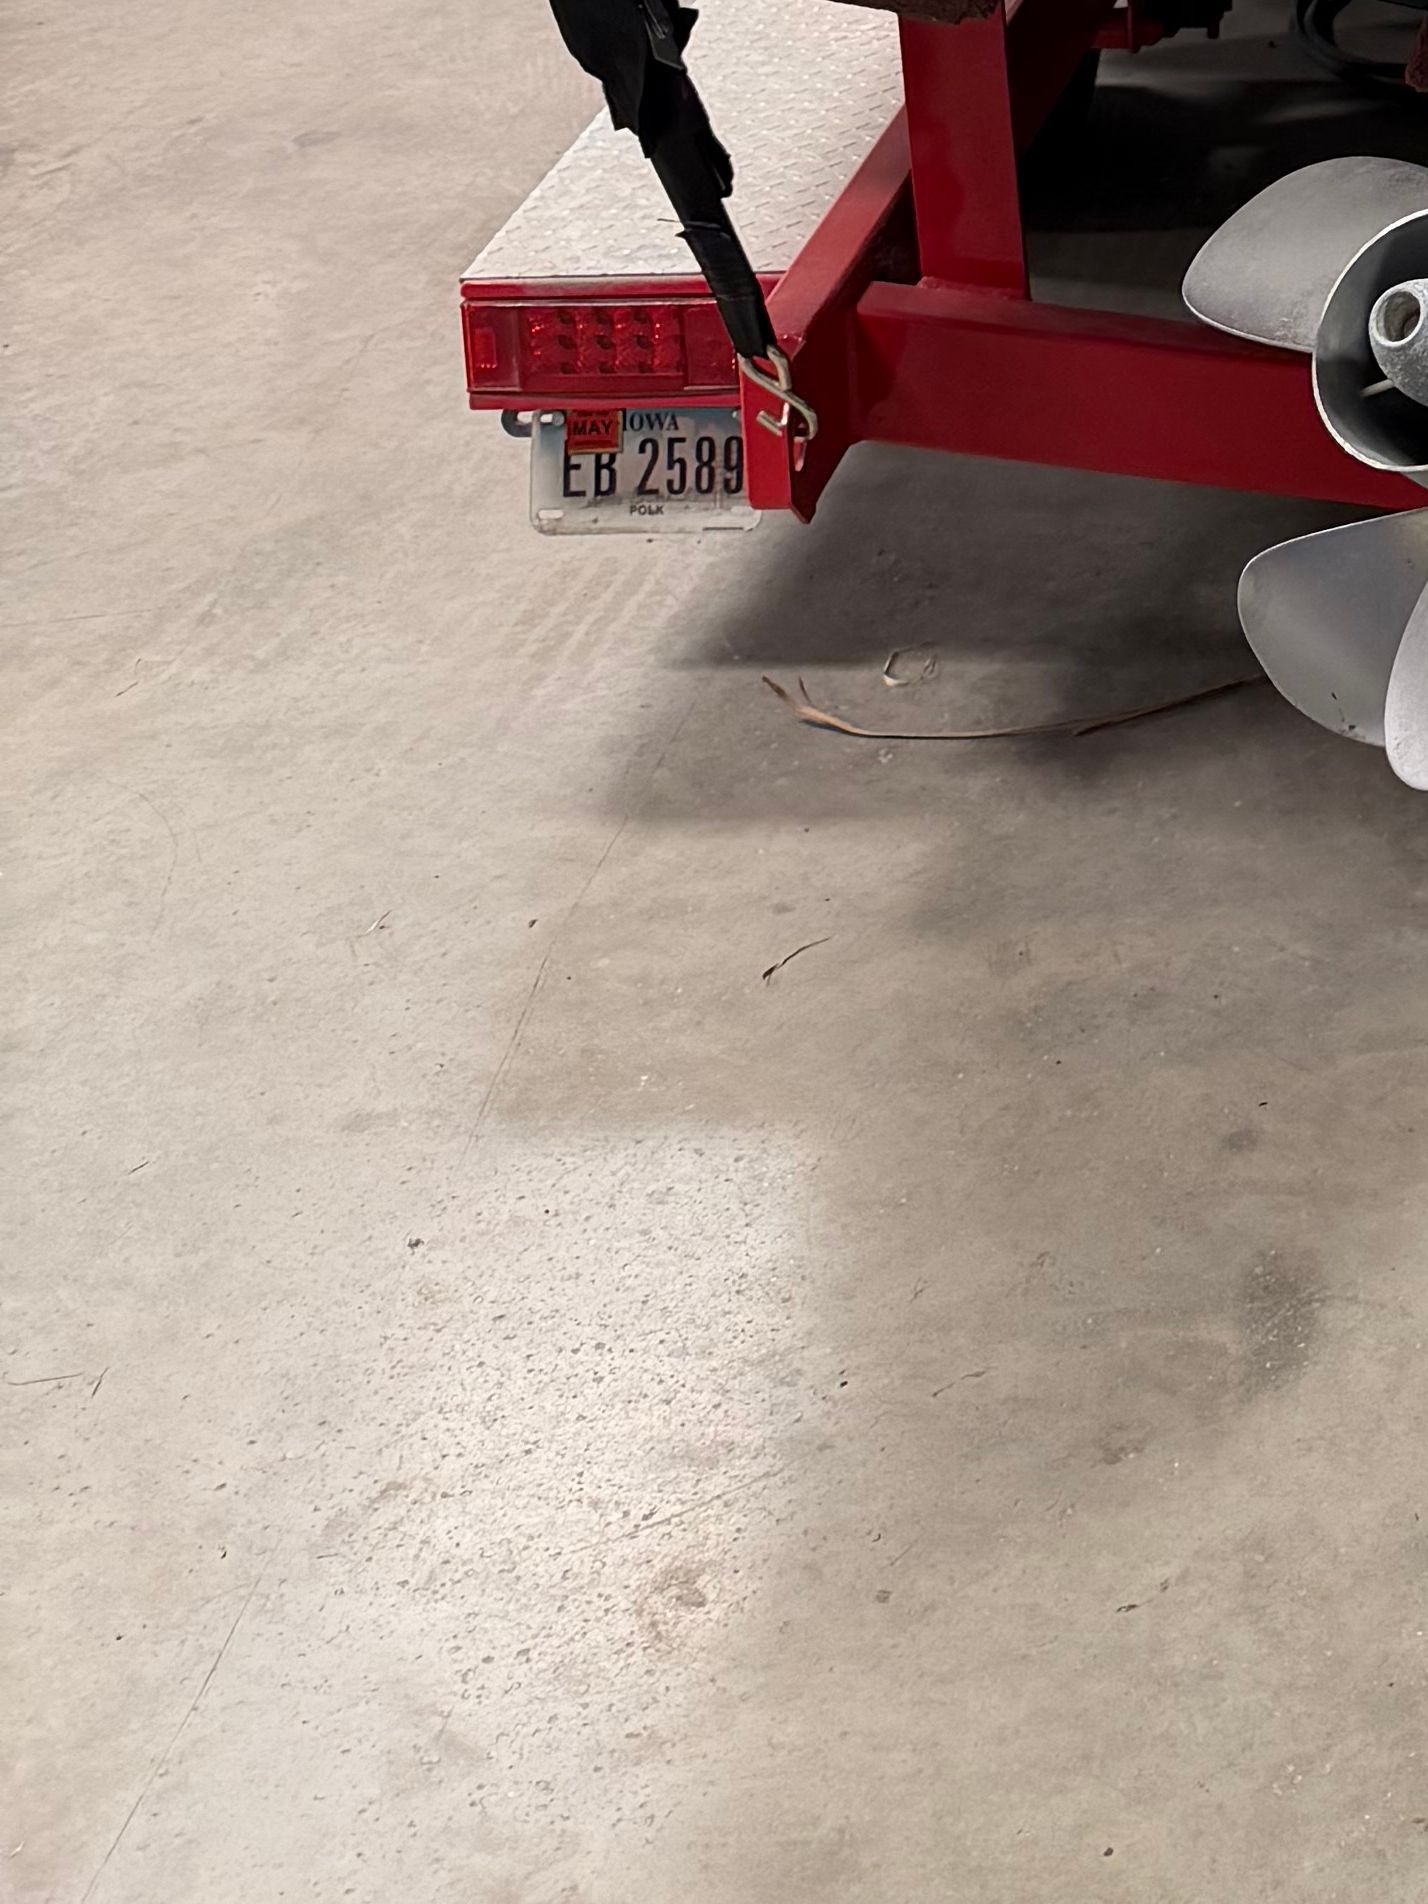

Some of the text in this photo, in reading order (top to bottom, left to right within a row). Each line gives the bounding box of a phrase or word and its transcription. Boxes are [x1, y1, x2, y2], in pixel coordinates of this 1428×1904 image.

[573, 419, 613, 436] MAY
[622, 410, 680, 432] IOWA
[563, 435, 744, 498] EB 2589
[629, 505, 665, 517] POLK
